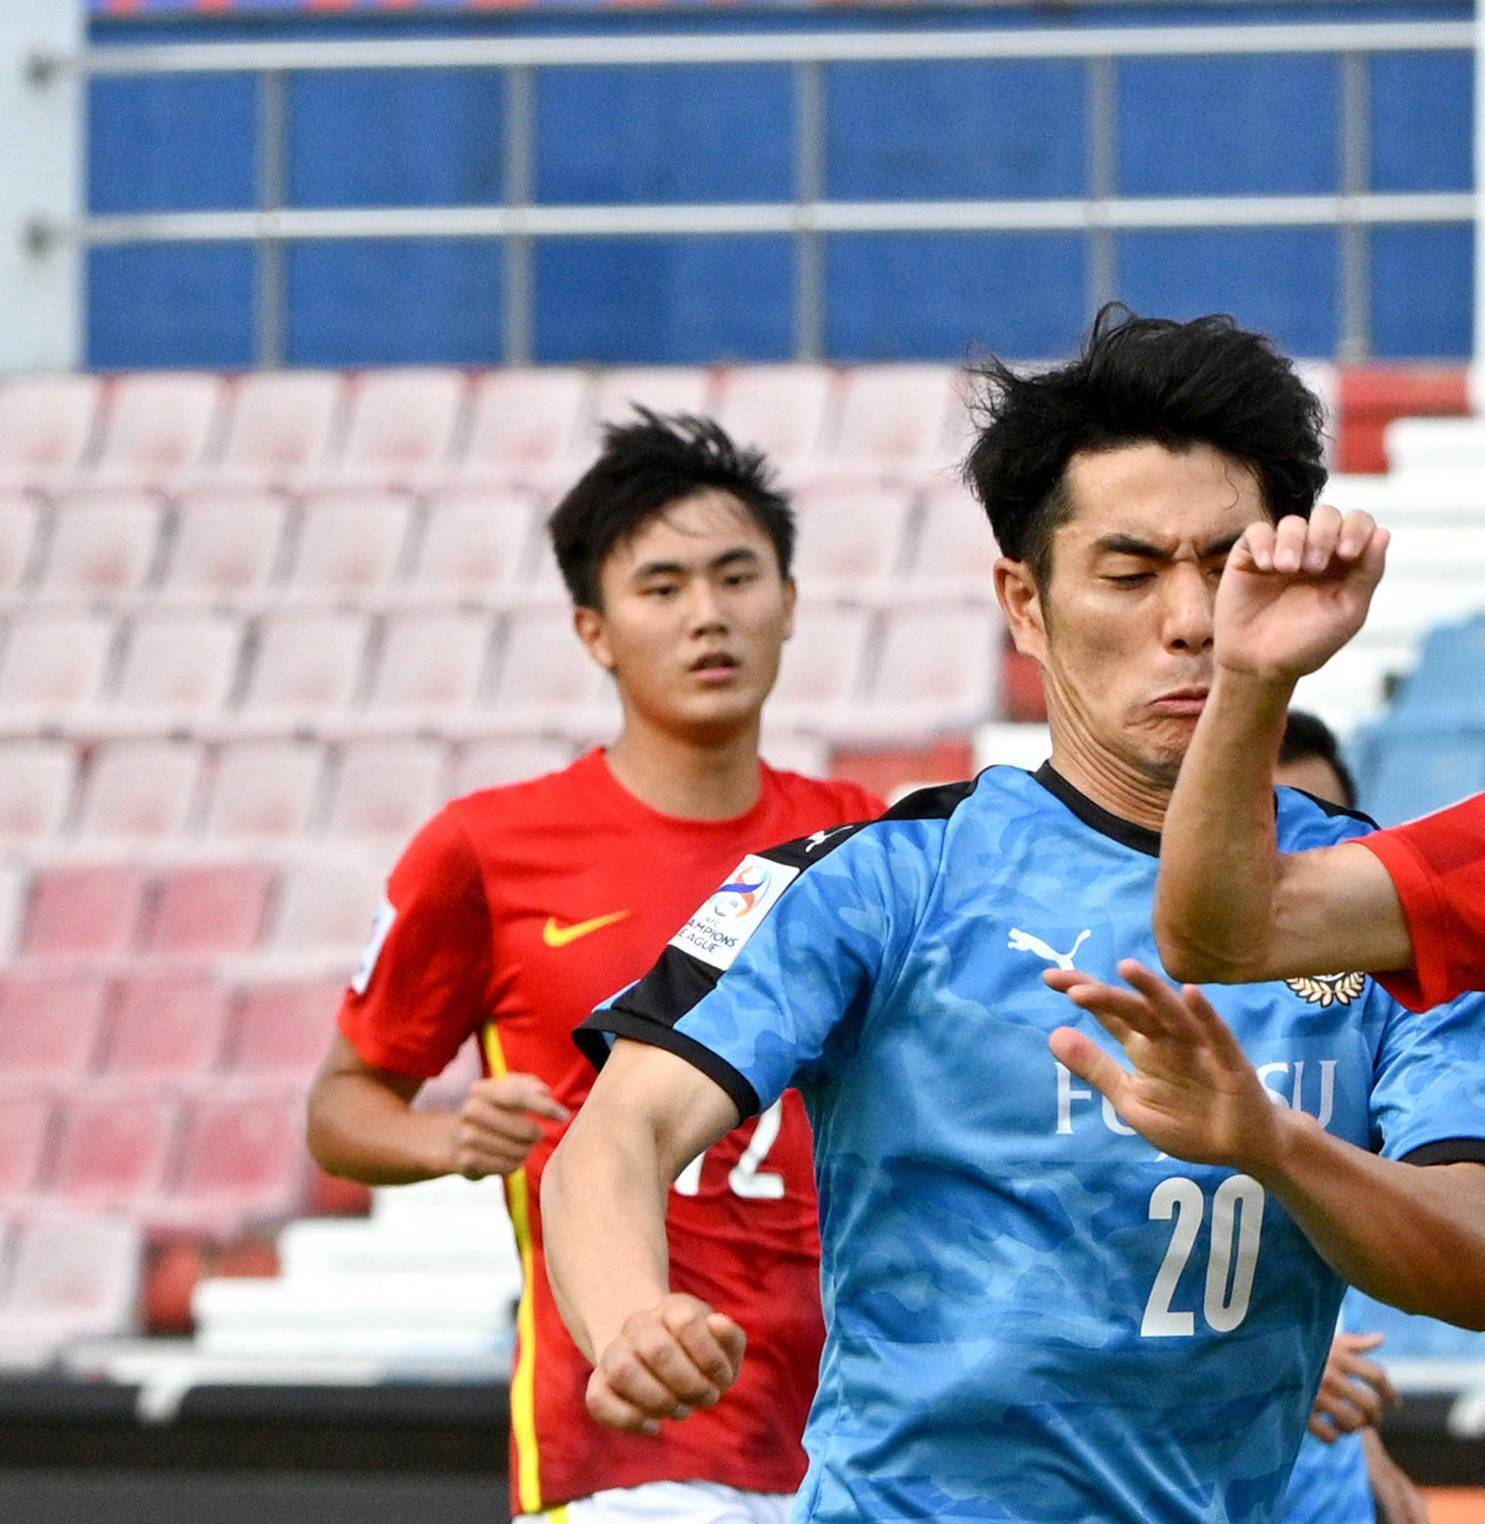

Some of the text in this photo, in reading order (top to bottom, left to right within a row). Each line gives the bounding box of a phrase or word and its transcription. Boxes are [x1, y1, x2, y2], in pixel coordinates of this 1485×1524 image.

[678, 928, 723, 954] EAGUE
[687, 918, 739, 948] AMPIONS
[1140, 1174, 1266, 1338] 20
